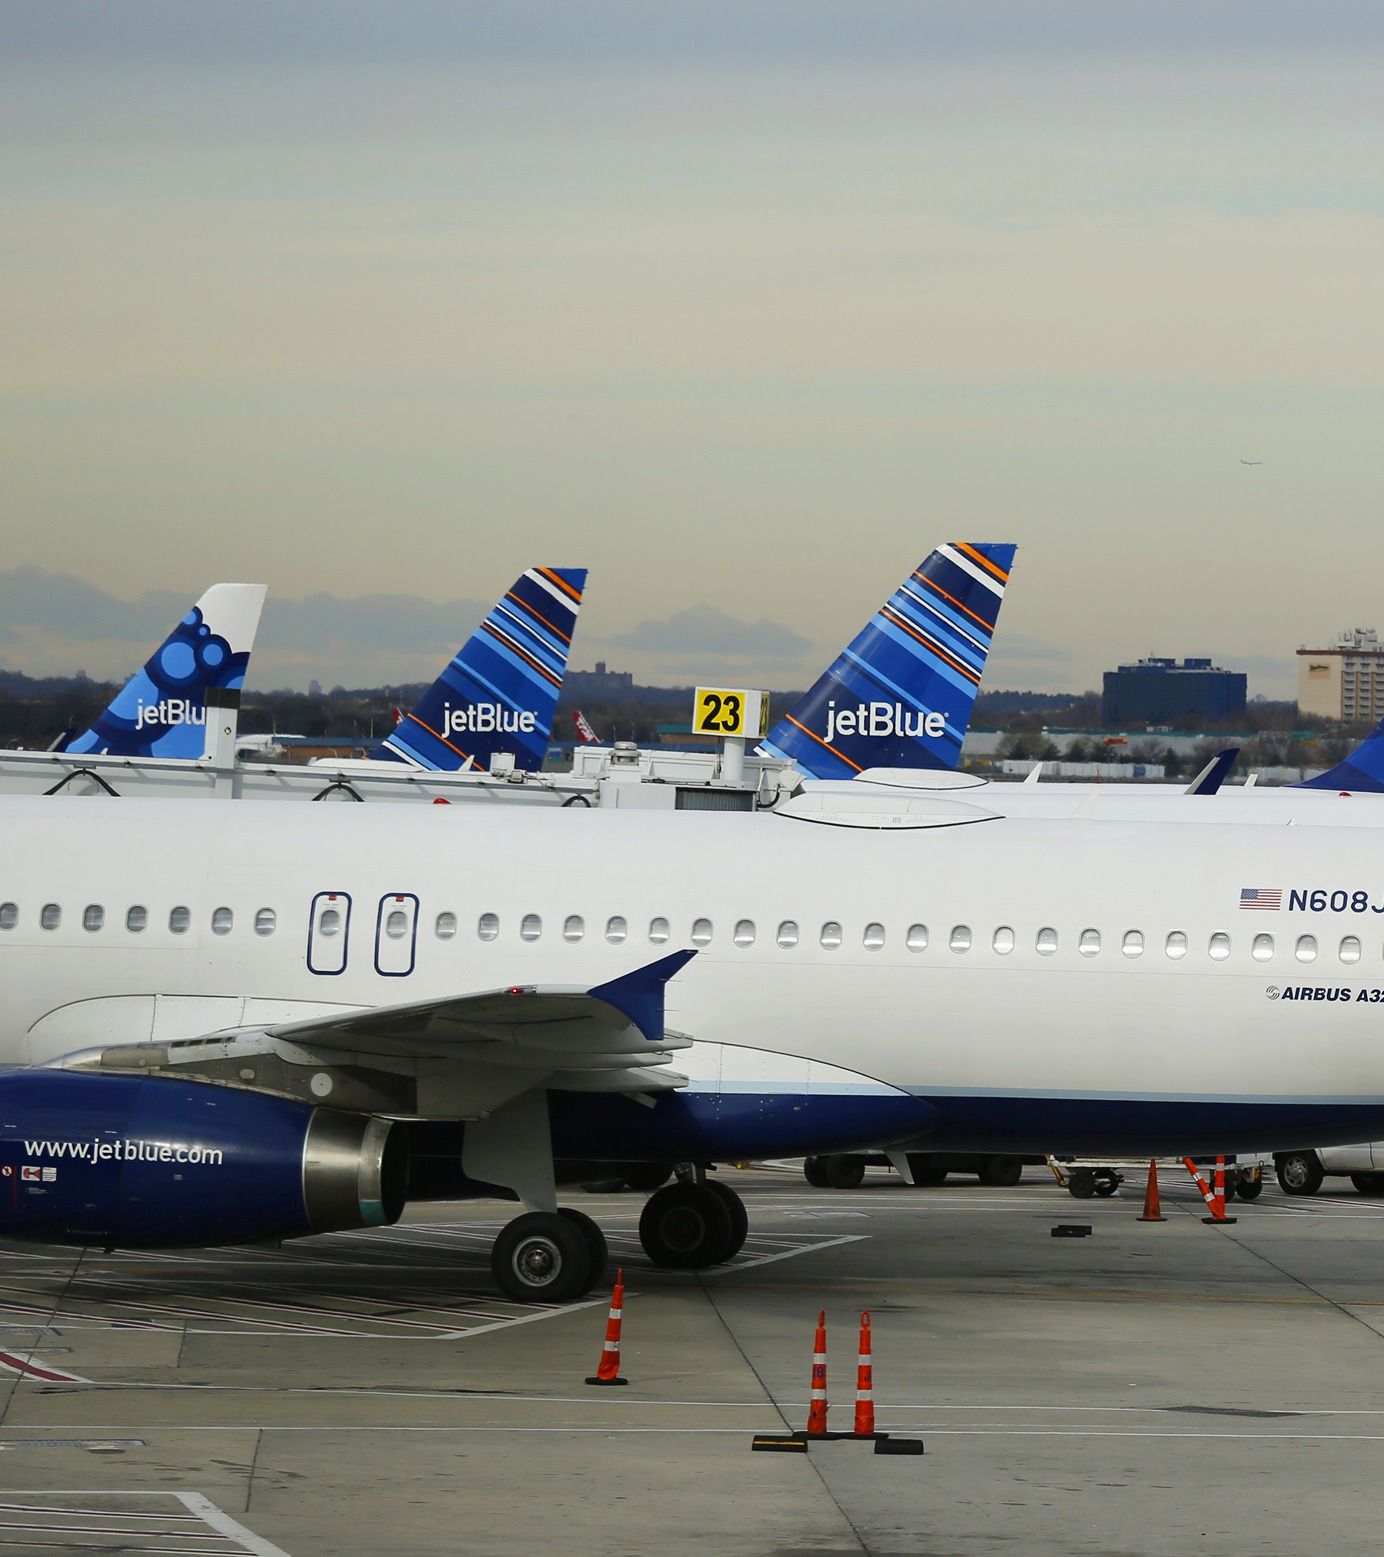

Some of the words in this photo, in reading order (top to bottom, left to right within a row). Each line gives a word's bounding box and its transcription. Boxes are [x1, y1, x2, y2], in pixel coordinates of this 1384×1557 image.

[441, 702, 536, 738] jetBlue
[701, 693, 740, 731] 23
[823, 701, 946, 742] jetBlue
[1281, 986, 1352, 1002] AIRBUS
[24, 1138, 223, 1165] www.jetblue.com
